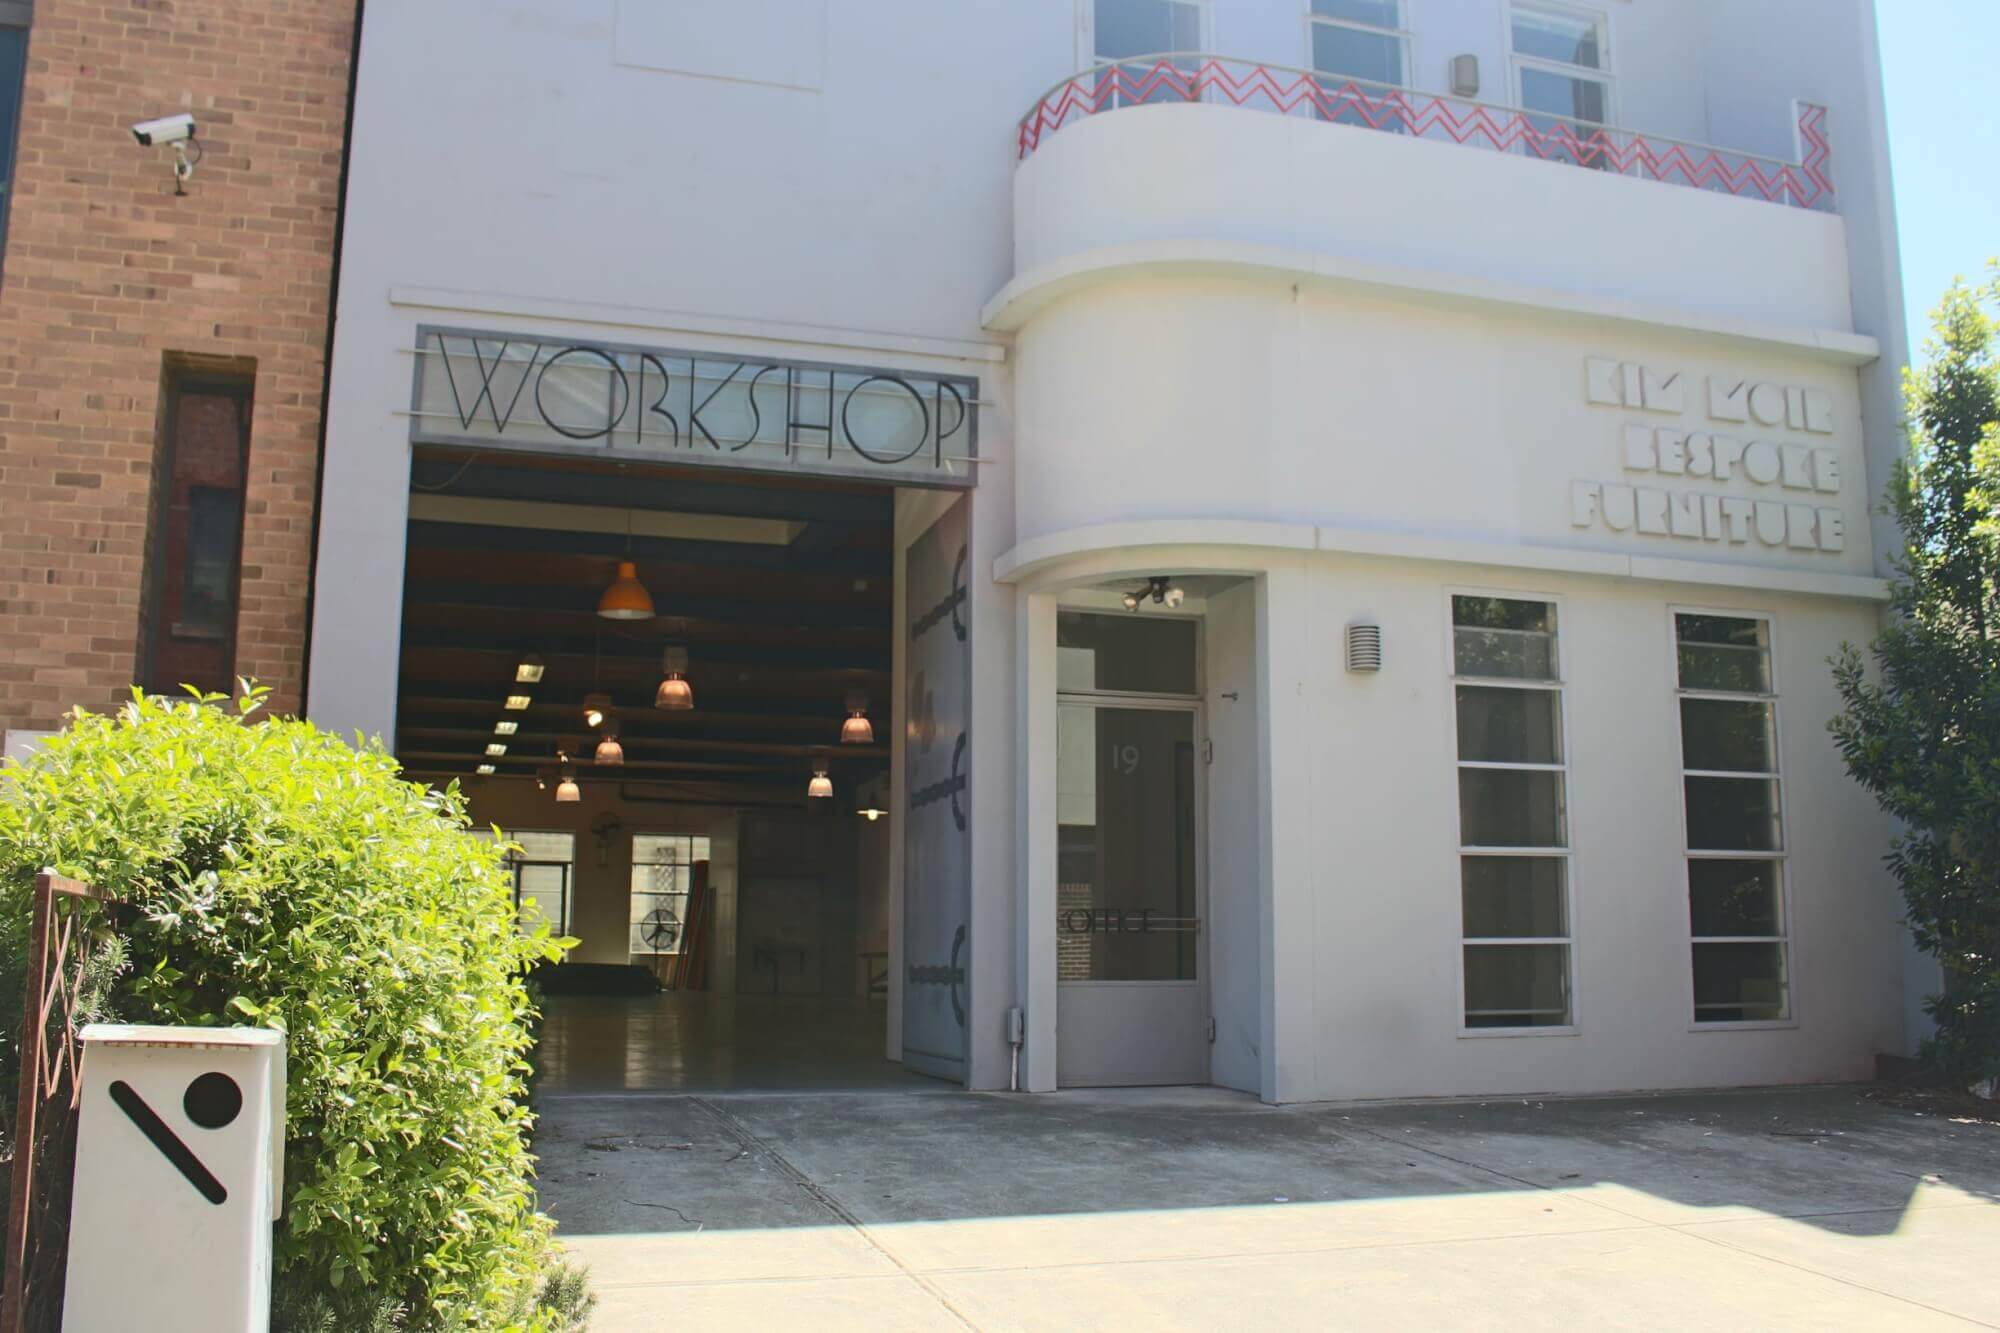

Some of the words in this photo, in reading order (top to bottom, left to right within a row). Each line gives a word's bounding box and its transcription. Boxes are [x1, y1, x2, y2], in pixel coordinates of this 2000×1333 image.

[438, 333, 966, 468] WORKSHOP
[1586, 356, 1683, 415] KIM
[1623, 421, 1840, 495] BESPOKE
[1571, 479, 1844, 553] FURNITURE
[1113, 744, 1140, 774] 19
[1066, 908, 1157, 934] OFFICE
